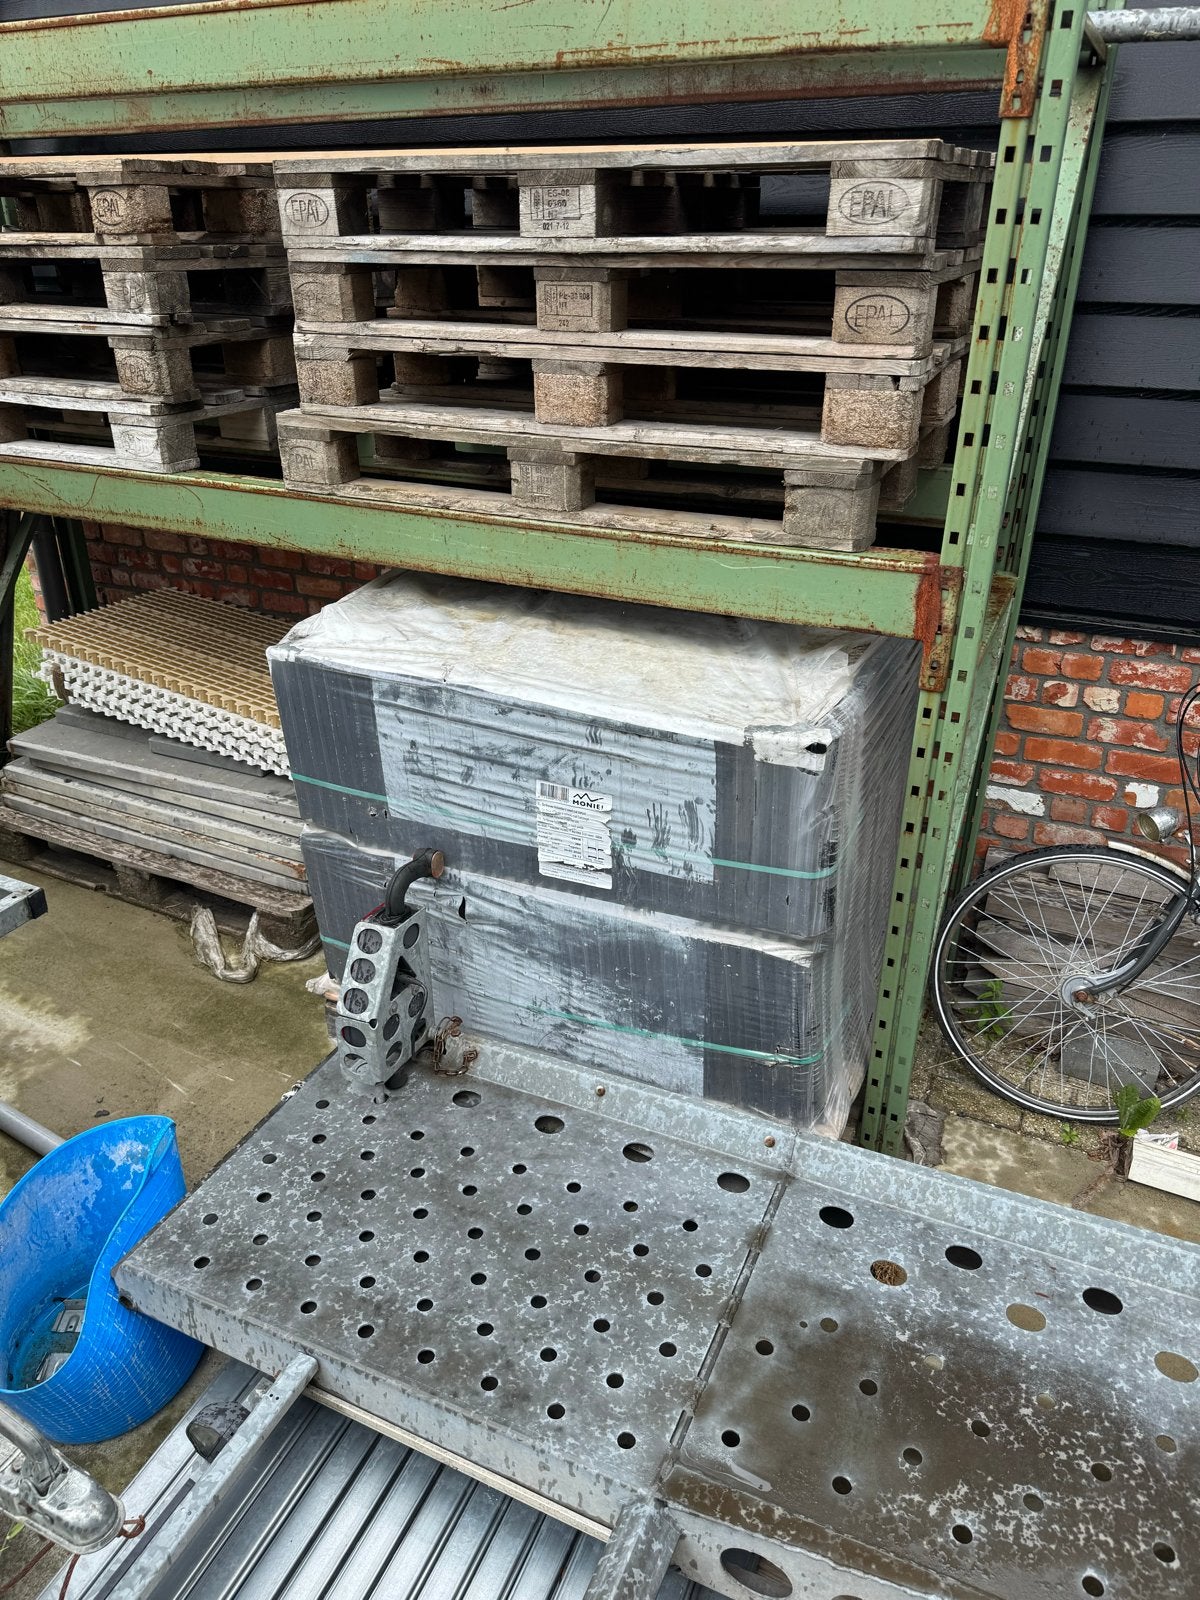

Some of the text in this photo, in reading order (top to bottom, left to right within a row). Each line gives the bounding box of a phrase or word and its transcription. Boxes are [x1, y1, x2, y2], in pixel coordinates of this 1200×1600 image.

[96, 198, 123, 218] EPAL
[291, 199, 323, 222] EPAL
[850, 190, 896, 218] EPAL
[854, 304, 899, 328] EPAL
[572, 800, 603, 810] MONIE
